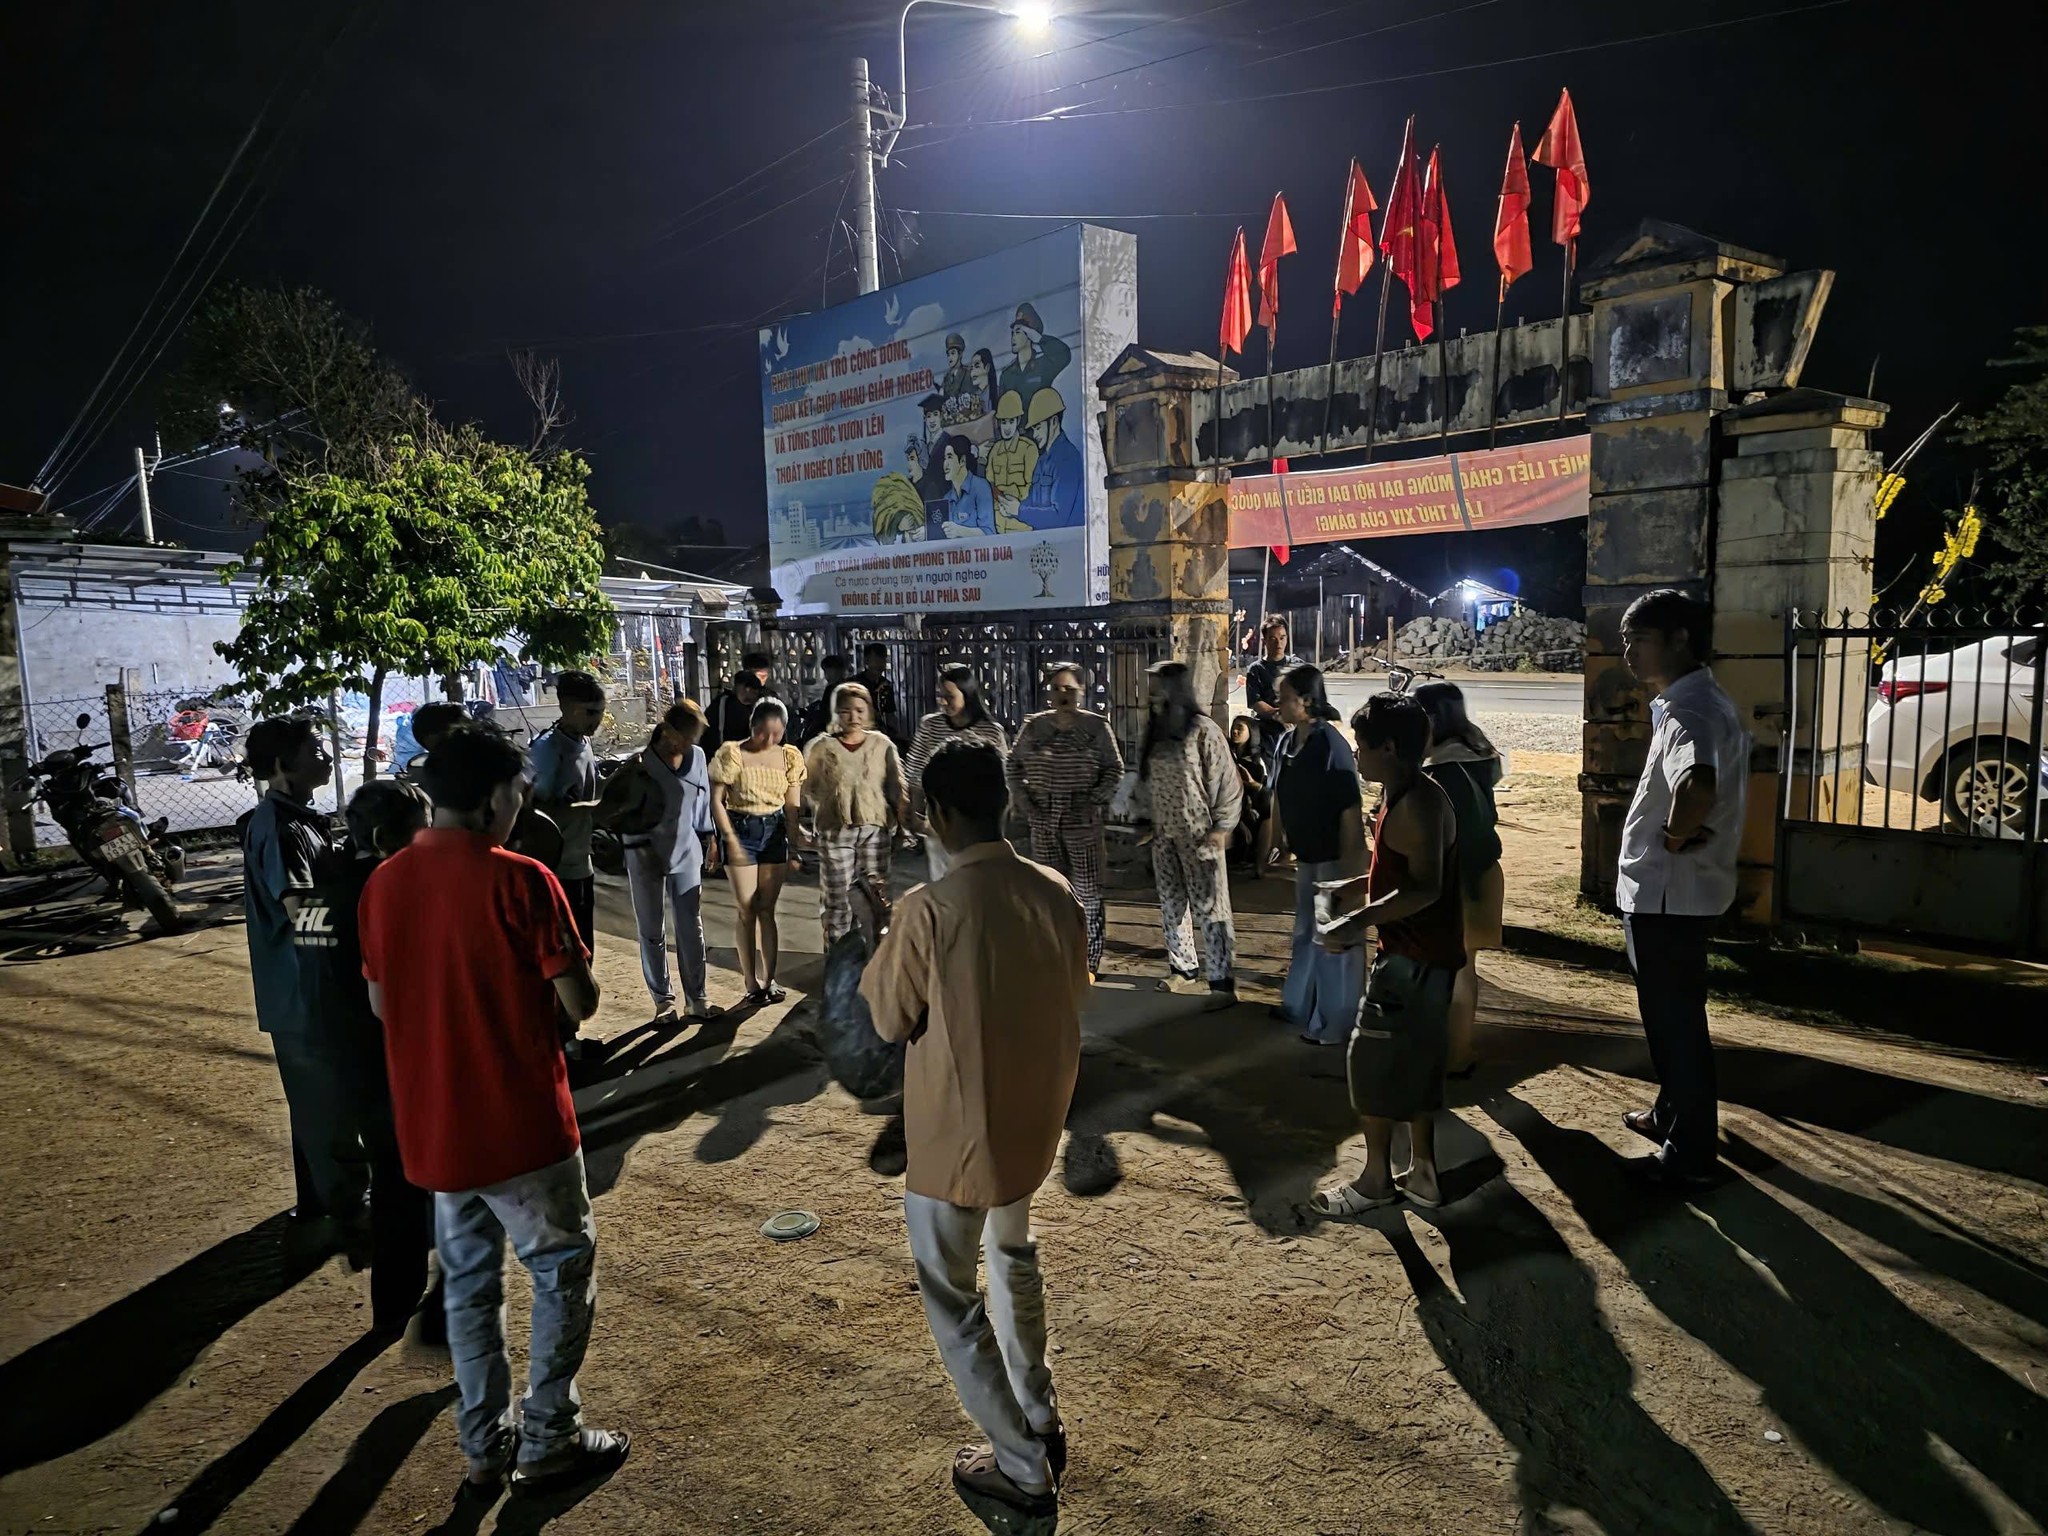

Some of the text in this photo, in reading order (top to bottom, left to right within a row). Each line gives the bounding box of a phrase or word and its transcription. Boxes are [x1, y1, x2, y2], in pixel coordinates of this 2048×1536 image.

[816, 390, 836, 415] GIÚP
[840, 384, 865, 408] NHAU
[868, 374, 894, 402] GIẢM
[866, 412, 885, 436] LÊN
[776, 460, 801, 485] THOÁT
[804, 456, 833, 480] NGHÈO
[857, 448, 883, 471] VỮNG
[913, 551, 944, 567] PHONG
[947, 547, 971, 565] TRÀO
[974, 547, 989, 562] THI
[993, 545, 1013, 561] ĐUA
[871, 574, 897, 589] chung
[900, 572, 914, 587] tay
[841, 590, 869, 606] KHÔNG
[884, 591, 892, 605] AI
[895, 591, 904, 608] BỊ
[906, 586, 918, 604] BỎ
[920, 590, 934, 607] LẠI
[962, 587, 981, 602] SAU
